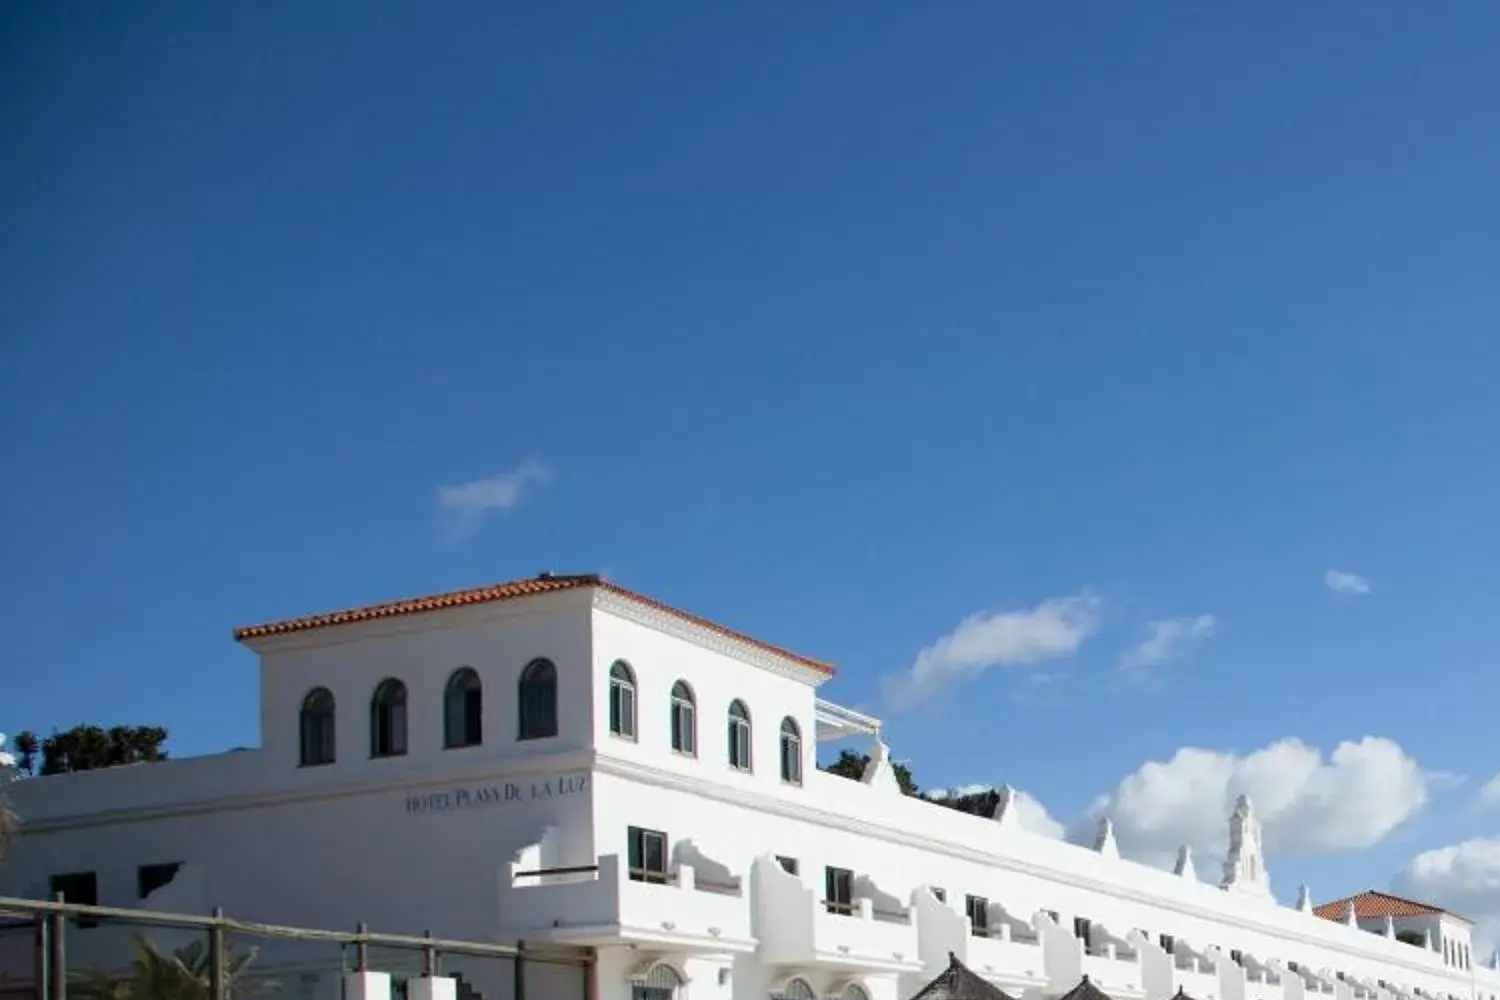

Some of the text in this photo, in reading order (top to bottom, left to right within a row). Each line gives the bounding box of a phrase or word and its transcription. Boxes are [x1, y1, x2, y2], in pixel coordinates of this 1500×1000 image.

[406, 791, 452, 813] HOTEL
[531, 783, 553, 800] LA
[558, 776, 586, 796] LUZ
